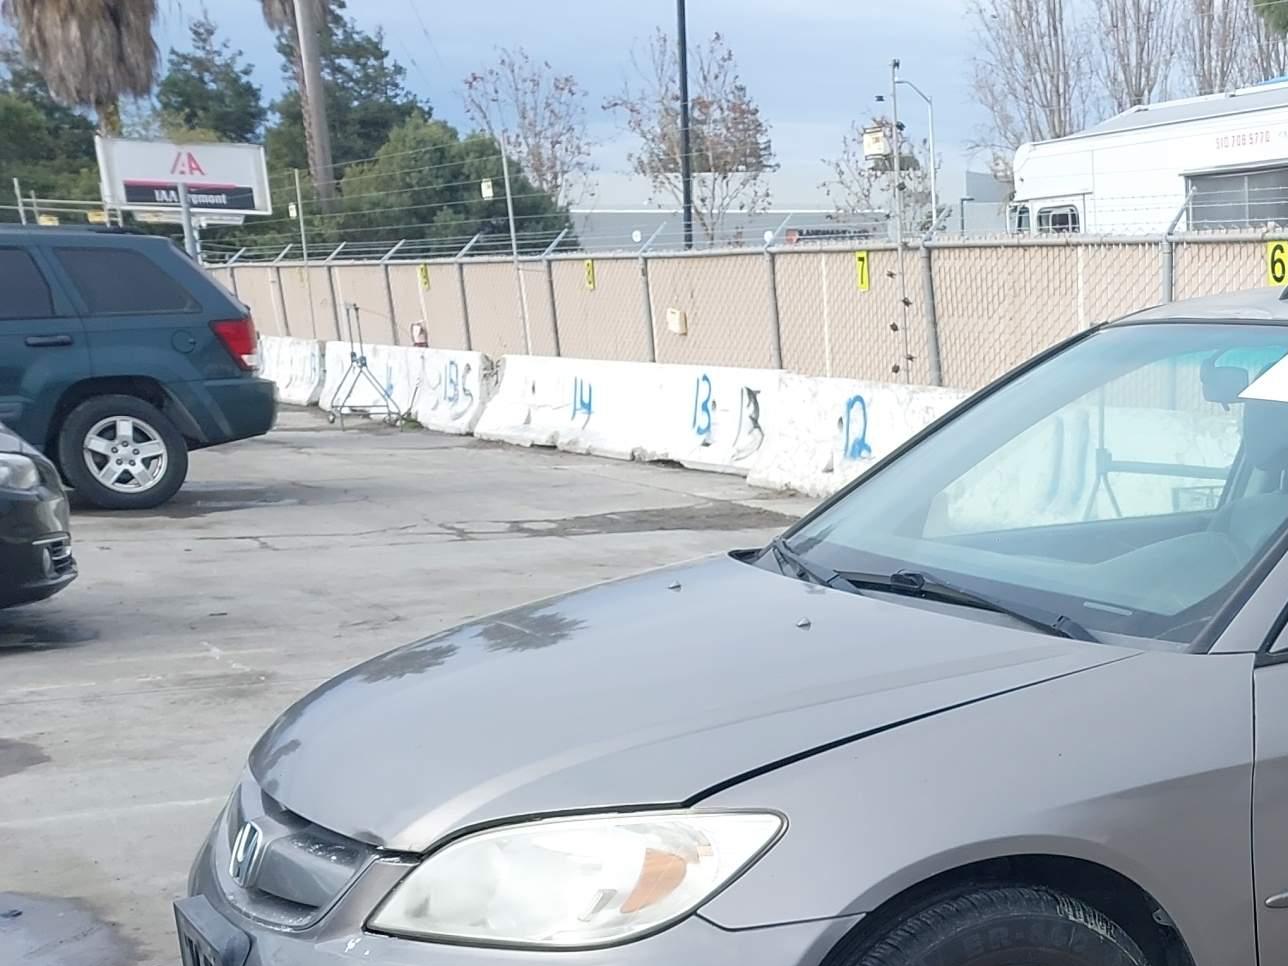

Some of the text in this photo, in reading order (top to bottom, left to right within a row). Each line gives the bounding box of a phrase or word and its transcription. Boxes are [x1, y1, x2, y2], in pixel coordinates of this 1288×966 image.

[154, 189, 178, 202] IAA
[857, 256, 865, 285] 7
[1271, 244, 1286, 283] 6
